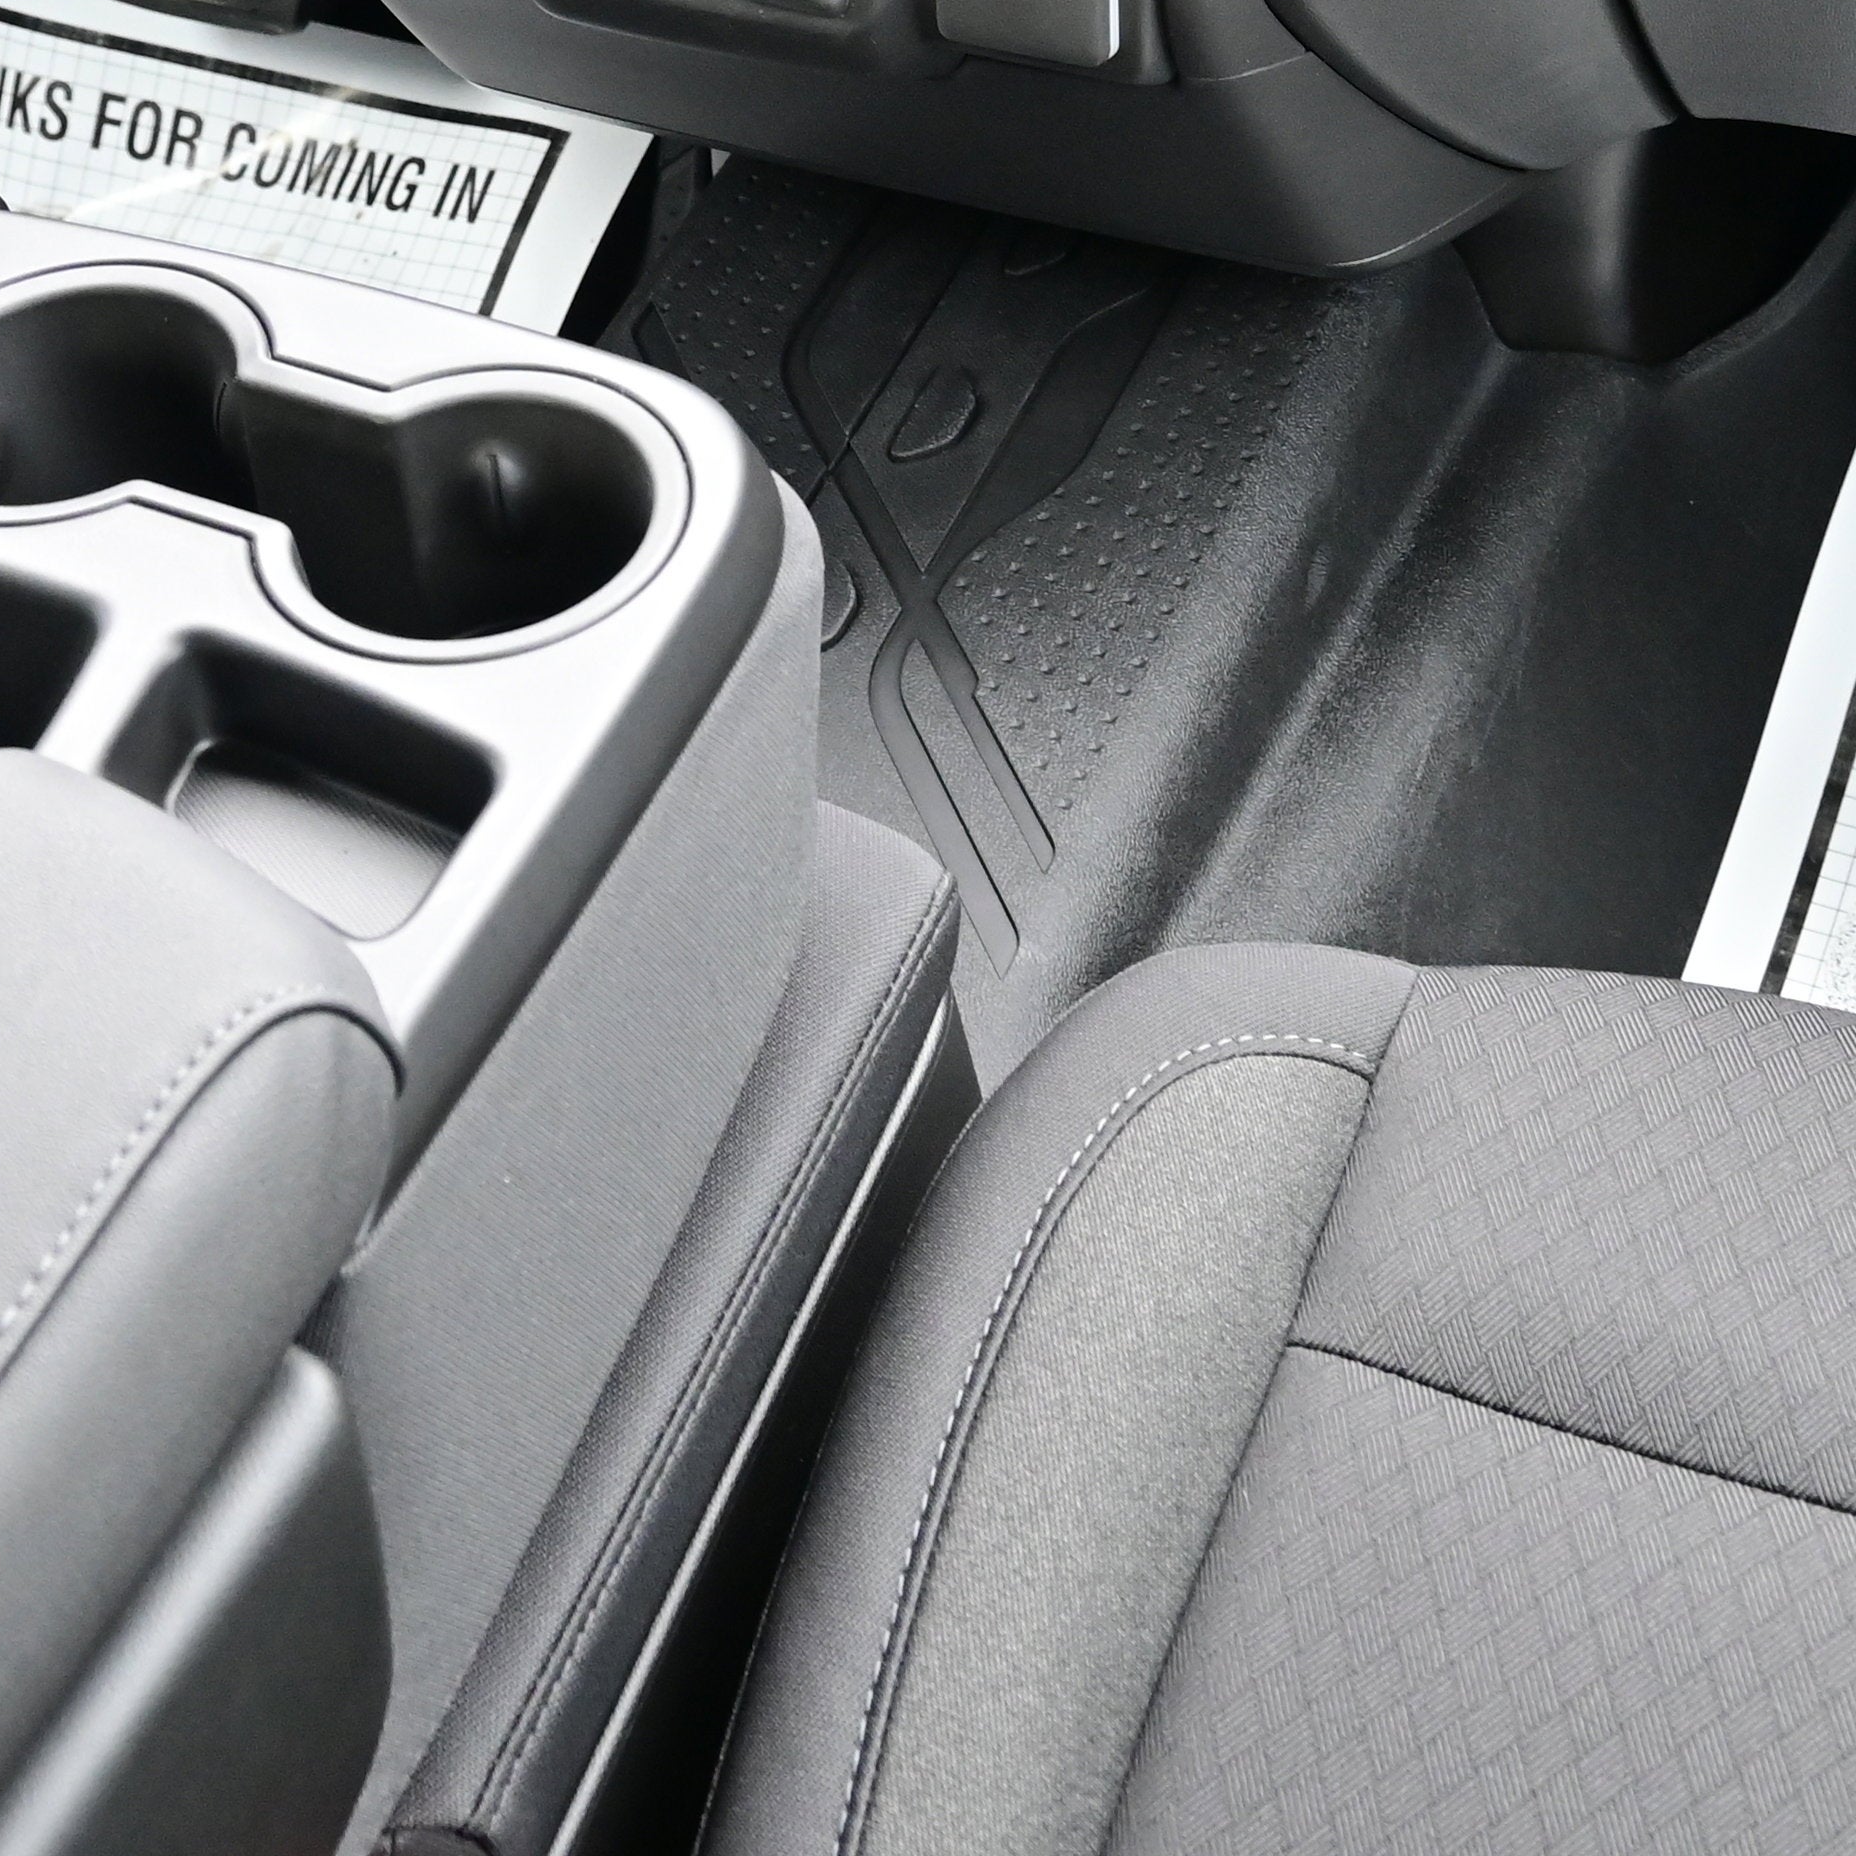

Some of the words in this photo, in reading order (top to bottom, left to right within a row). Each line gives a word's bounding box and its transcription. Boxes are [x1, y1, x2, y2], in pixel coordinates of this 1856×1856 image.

[91, 91, 203, 170] FOR
[220, 122, 426, 213] COMING
[433, 162, 496, 224] IN
